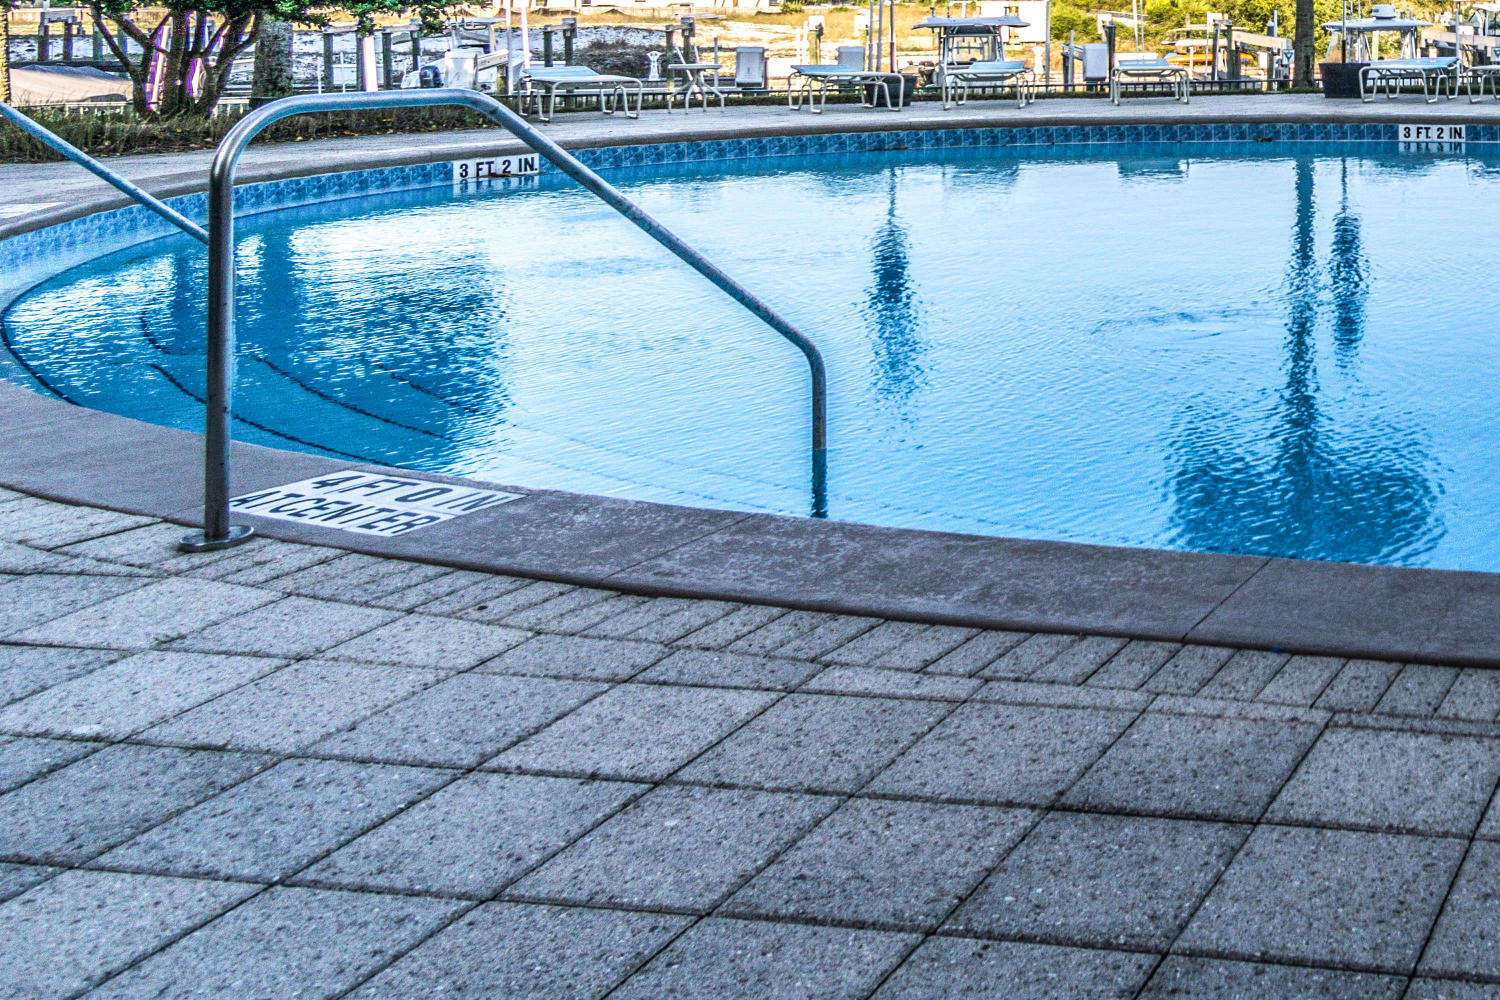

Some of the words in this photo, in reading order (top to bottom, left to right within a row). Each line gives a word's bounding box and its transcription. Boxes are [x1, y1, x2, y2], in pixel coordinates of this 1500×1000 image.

[1403, 127, 1411, 139] 3
[1436, 127, 1444, 139] 2
[459, 163, 468, 178] 3
[502, 159, 511, 175] 2
[518, 157, 537, 173] IN.
[311, 475, 366, 489] 4
[338, 478, 420, 496] FT
[433, 492, 509, 512] IN
